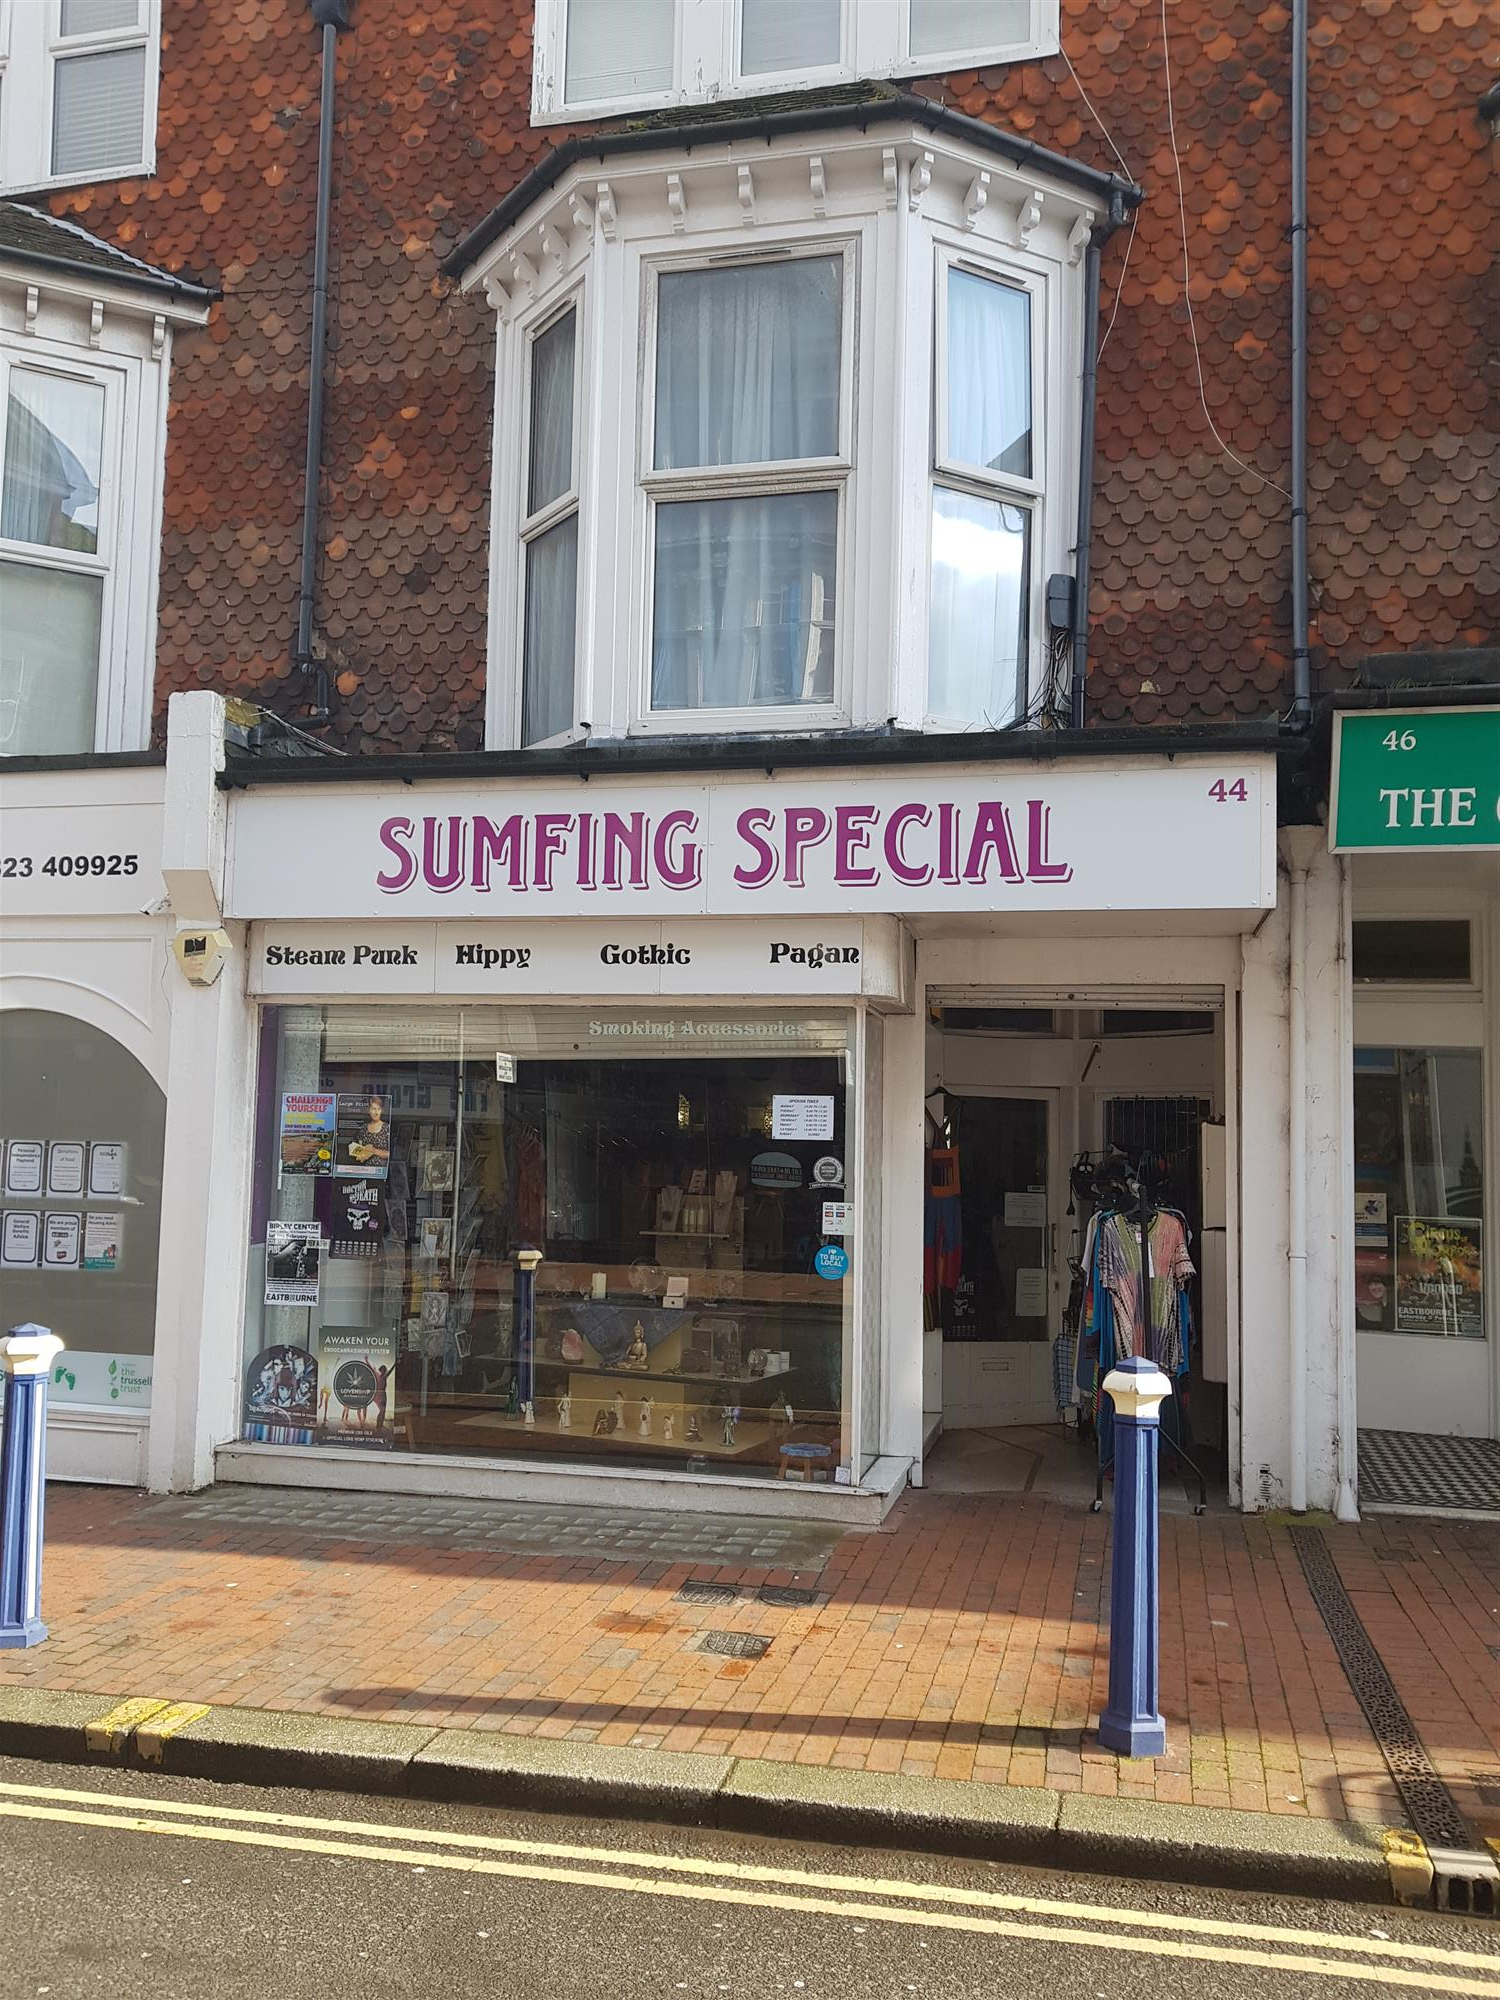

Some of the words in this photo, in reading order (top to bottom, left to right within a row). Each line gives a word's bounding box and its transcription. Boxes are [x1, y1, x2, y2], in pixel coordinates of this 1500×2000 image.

[1382, 729, 1417, 751] 46
[1208, 778, 1248, 802] 44
[1379, 787, 1477, 828] THE
[377, 809, 703, 895] SUMFING
[733, 800, 1074, 890] SPECIAL
[0, 857, 33, 878] 23
[42, 854, 139, 877] 409925
[266, 945, 346, 966] Steam
[353, 945, 418, 965] Punk
[455, 943, 531, 969] Hippy
[600, 943, 691, 965] Gothic
[769, 943, 860, 969] Pagan
[588, 1020, 675, 1039] Smoking
[681, 1020, 808, 1036] Accessories
[286, 1095, 333, 1105] CHALLENGE
[286, 1104, 328, 1113] YOURSELF
[324, 1336, 363, 1345] AWAKEN
[365, 1336, 390, 1346] YOUR
[121, 1367, 136, 1376] the
[121, 1376, 153, 1386] trussell
